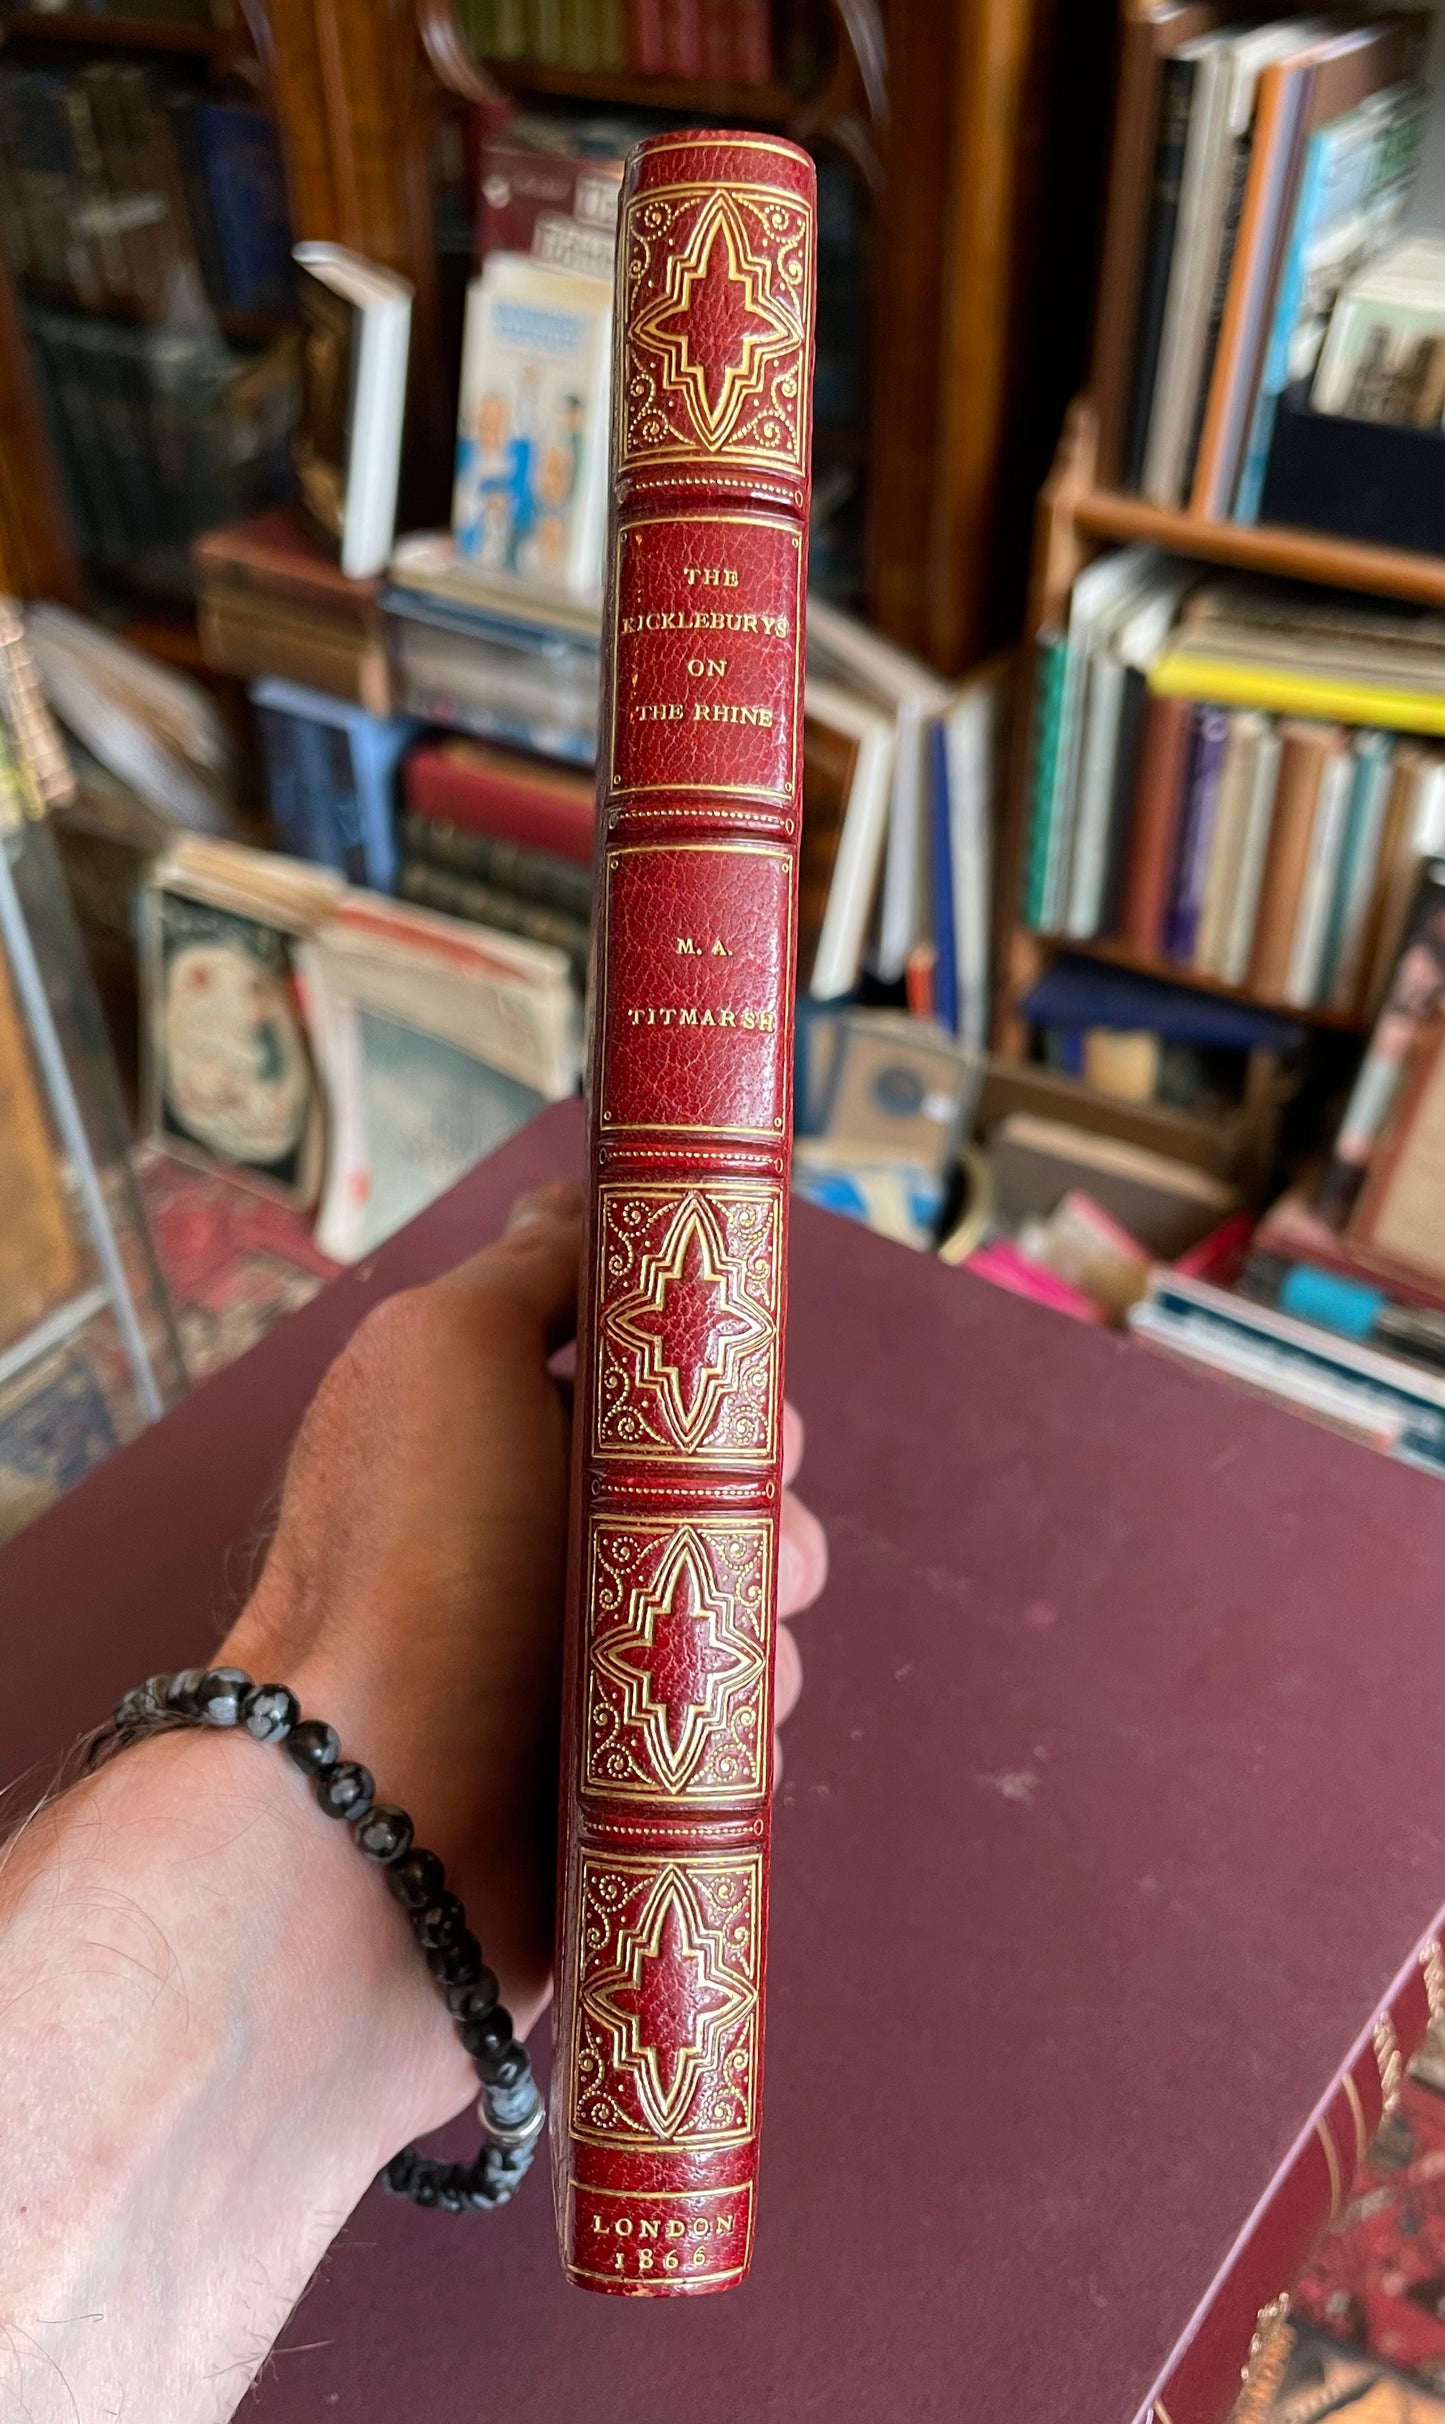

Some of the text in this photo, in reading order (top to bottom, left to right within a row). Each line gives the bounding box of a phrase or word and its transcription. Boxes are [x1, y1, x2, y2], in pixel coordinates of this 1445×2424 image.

[684, 568, 739, 587] THE
[621, 612, 788, 639] KICKLEBURYS
[687, 659, 727, 677] ON
[636, 703, 773, 728] THE RHINE
[676, 938, 734, 956] M. A.
[628, 1008, 776, 1032] TITMARSH
[593, 2214, 734, 2238] LONDON
[614, 2246, 707, 2270] 1866
